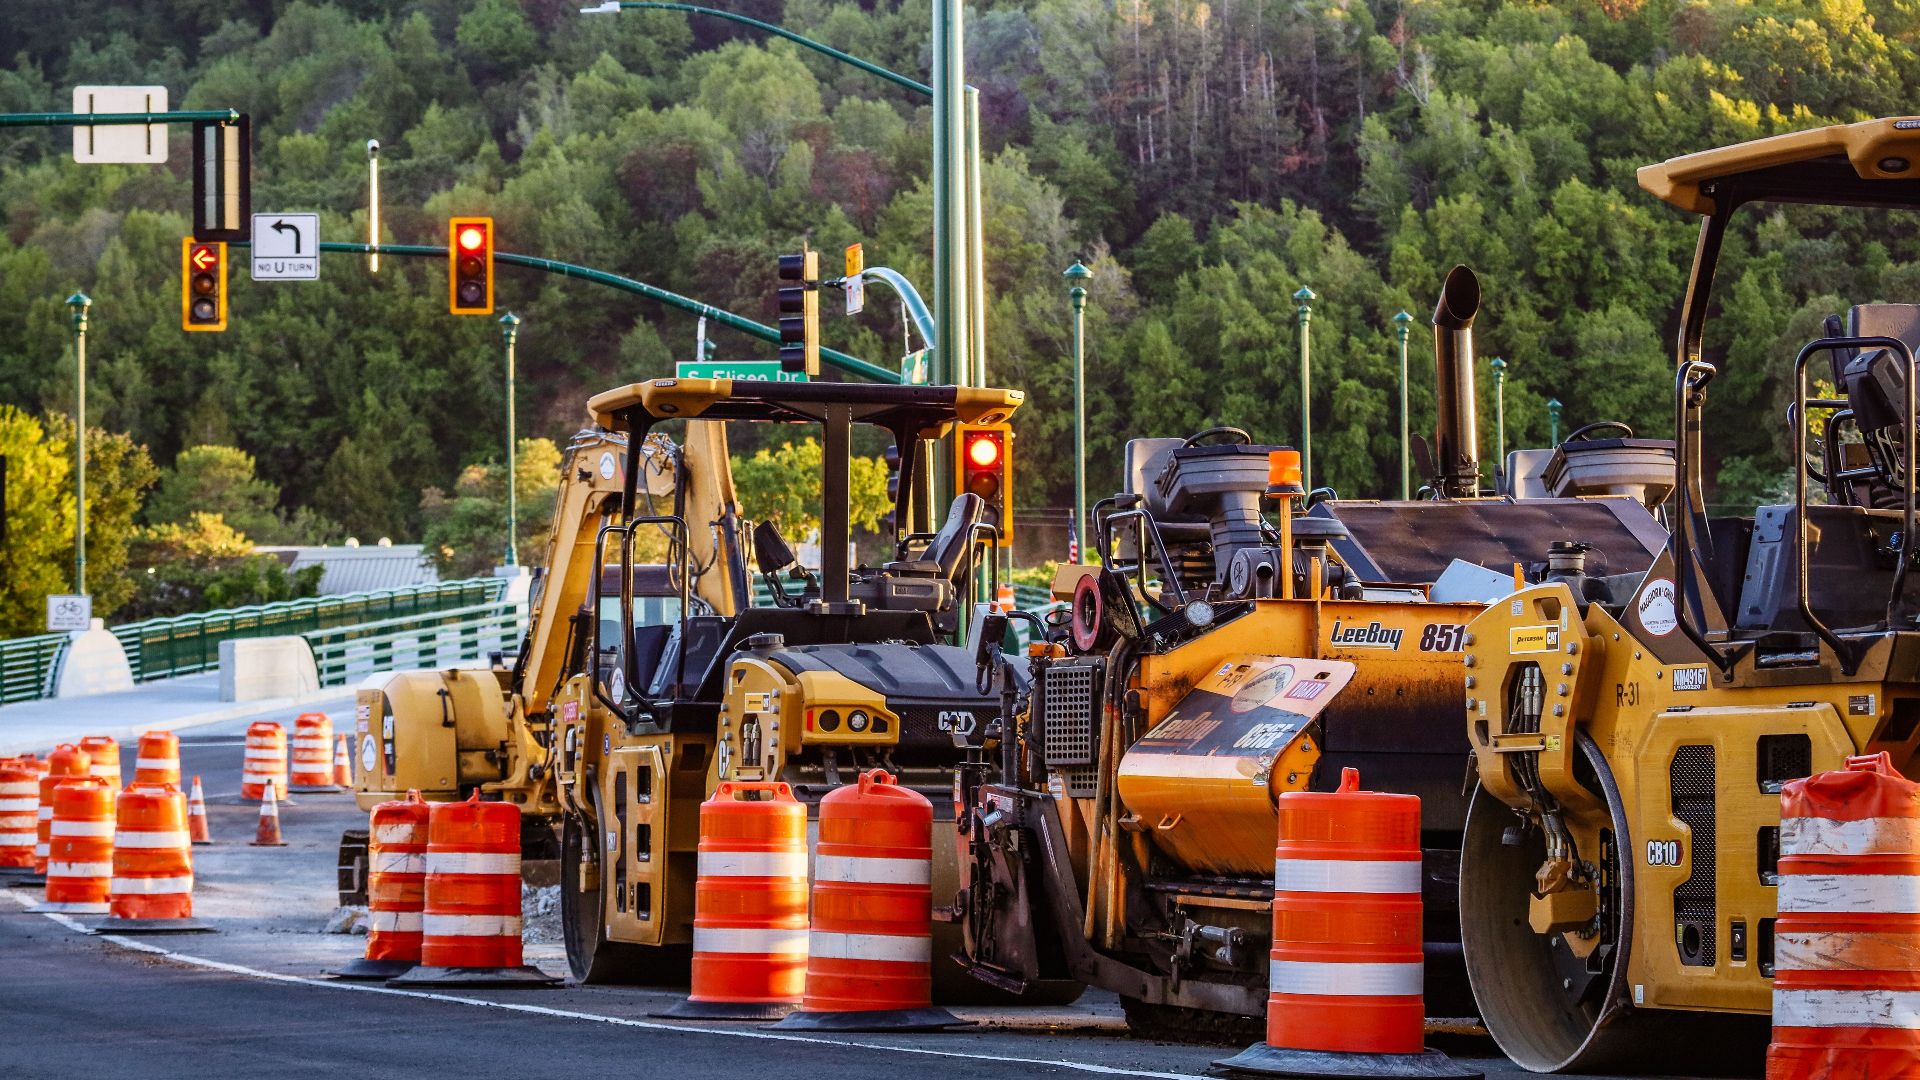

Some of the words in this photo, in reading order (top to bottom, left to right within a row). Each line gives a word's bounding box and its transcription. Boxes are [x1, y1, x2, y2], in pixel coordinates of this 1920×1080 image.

[274, 261, 285, 274] U
[288, 263, 312, 272] TURN
[1331, 621, 1403, 651] LeeBoy
[1419, 623, 1465, 652] 851
[1547, 631, 1558, 645] CAT
[1673, 668, 1707, 686] NM49167
[1616, 682, 1640, 707] R-31
[1143, 711, 1224, 750] LeeBoy
[1647, 840, 1677, 865] CB10
